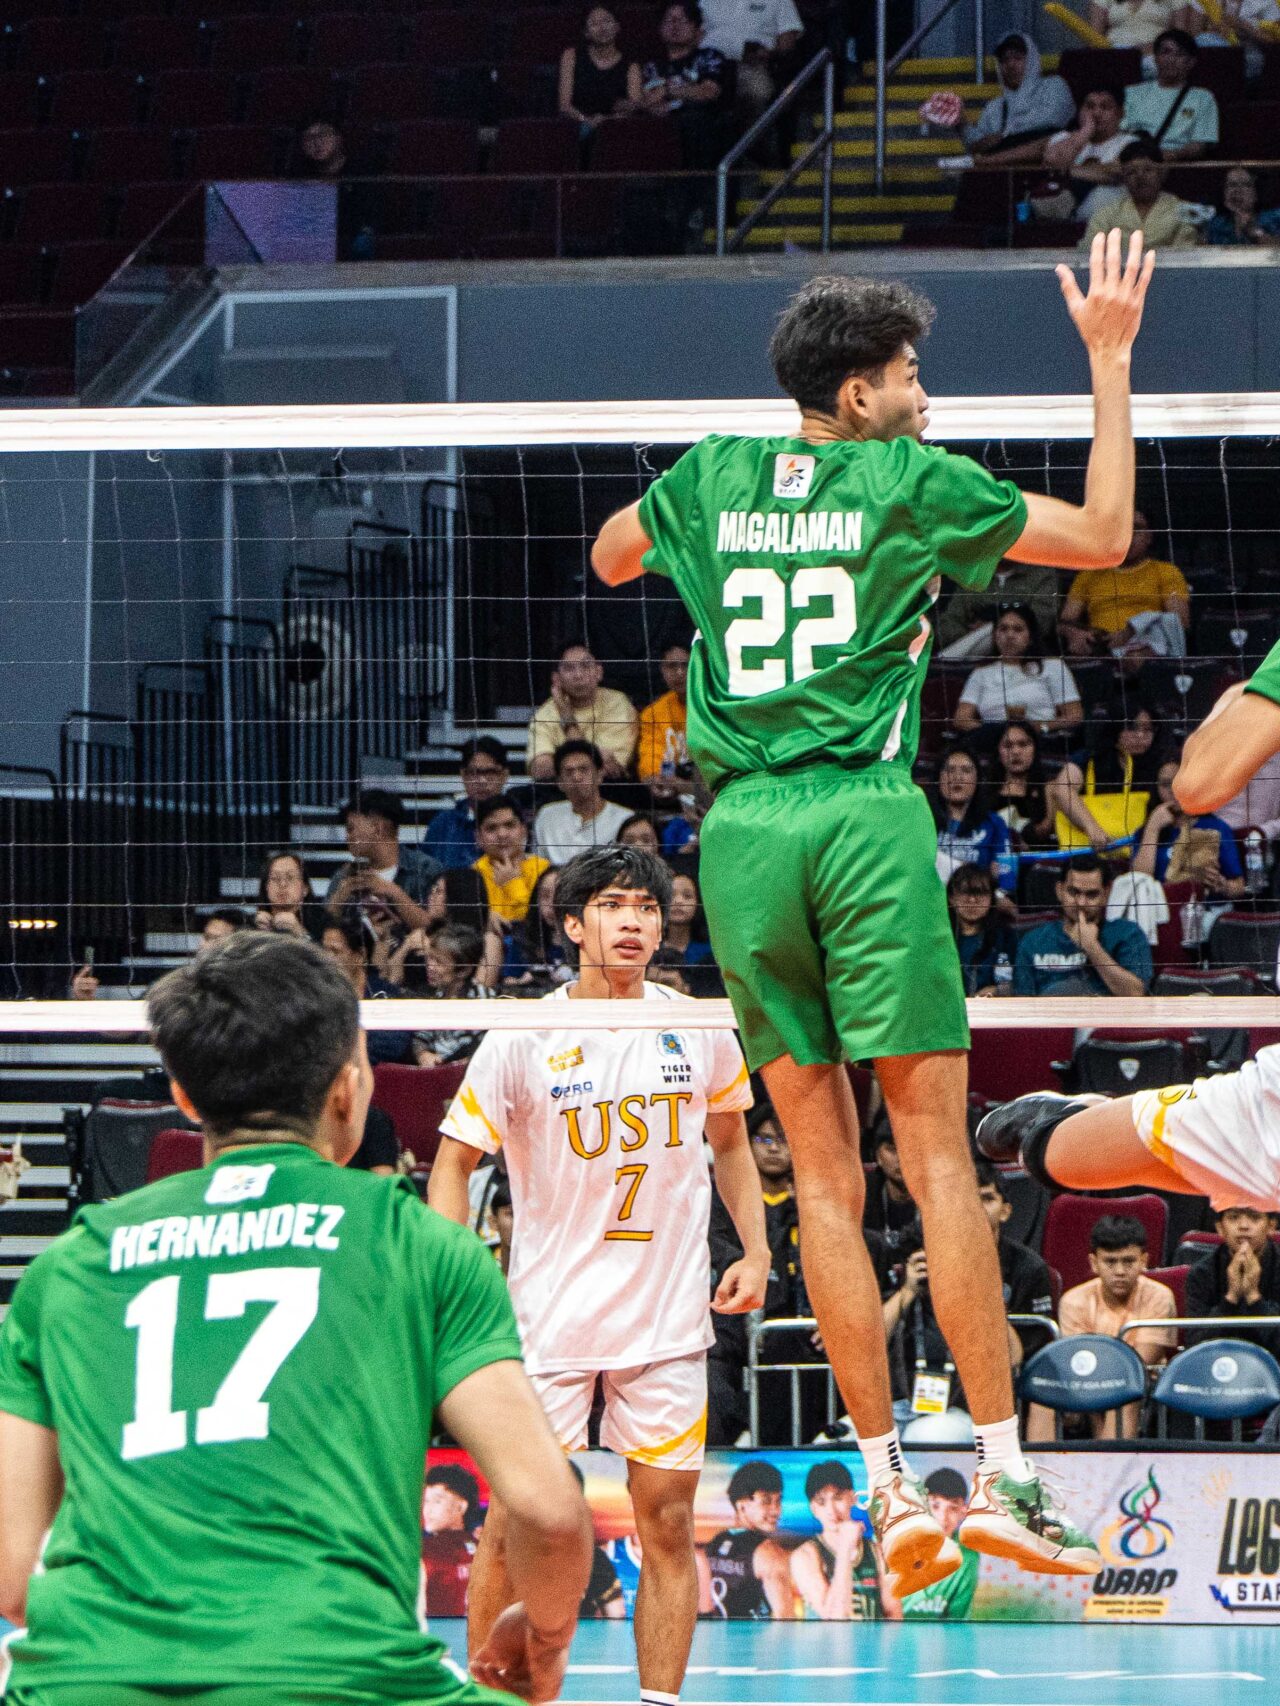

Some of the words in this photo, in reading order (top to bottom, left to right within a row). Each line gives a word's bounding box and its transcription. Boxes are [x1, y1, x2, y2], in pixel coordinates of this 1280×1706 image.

[716, 511, 863, 554] MAGALAMAN
[722, 566, 857, 697] 22
[660, 1064, 692, 1073] TIGER
[560, 1092, 693, 1160] UST
[614, 1163, 648, 1221] 7
[110, 1203, 345, 1273] HERNANDEZ
[120, 1267, 321, 1461] 17
[1093, 1567, 1177, 1595] UAAP
